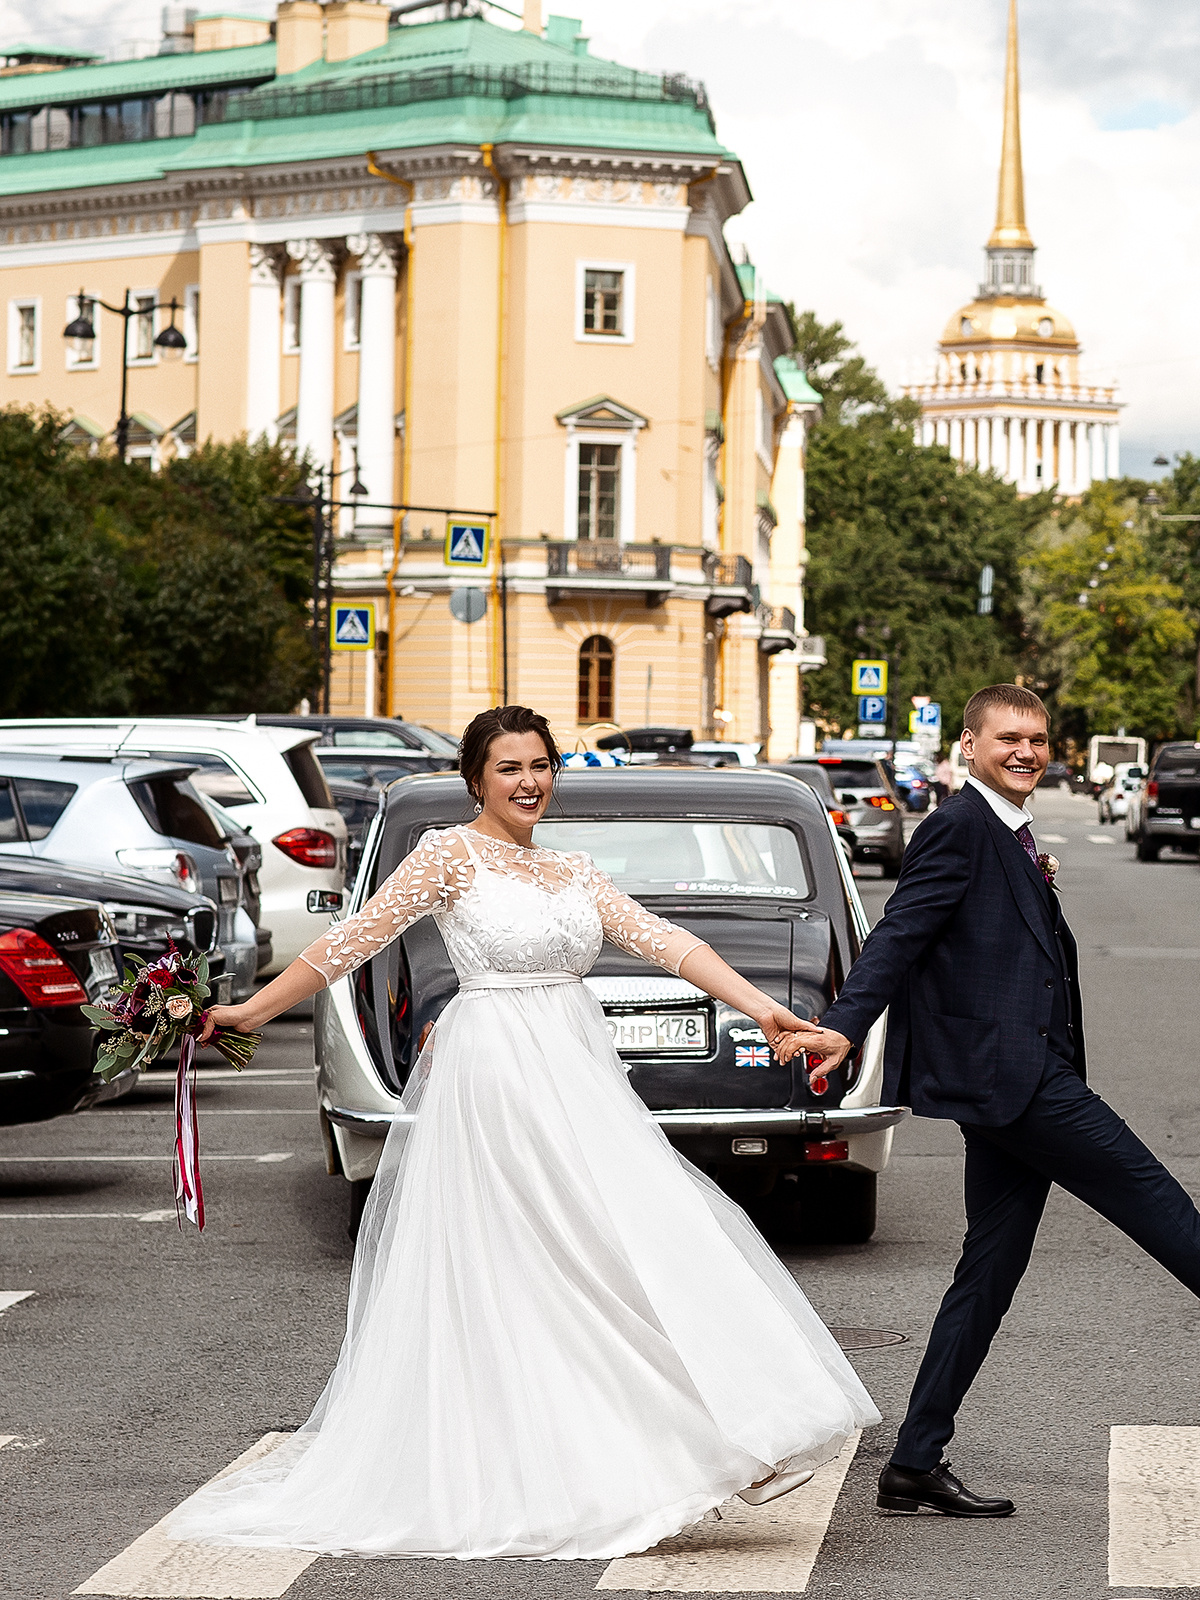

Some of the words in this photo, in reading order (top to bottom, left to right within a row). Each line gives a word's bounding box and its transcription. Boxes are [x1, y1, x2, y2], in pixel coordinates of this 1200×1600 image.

[866, 697, 883, 720] P
[923, 704, 938, 723] P
[659, 1017, 697, 1038] 178
[667, 1036, 687, 1045] RUS
